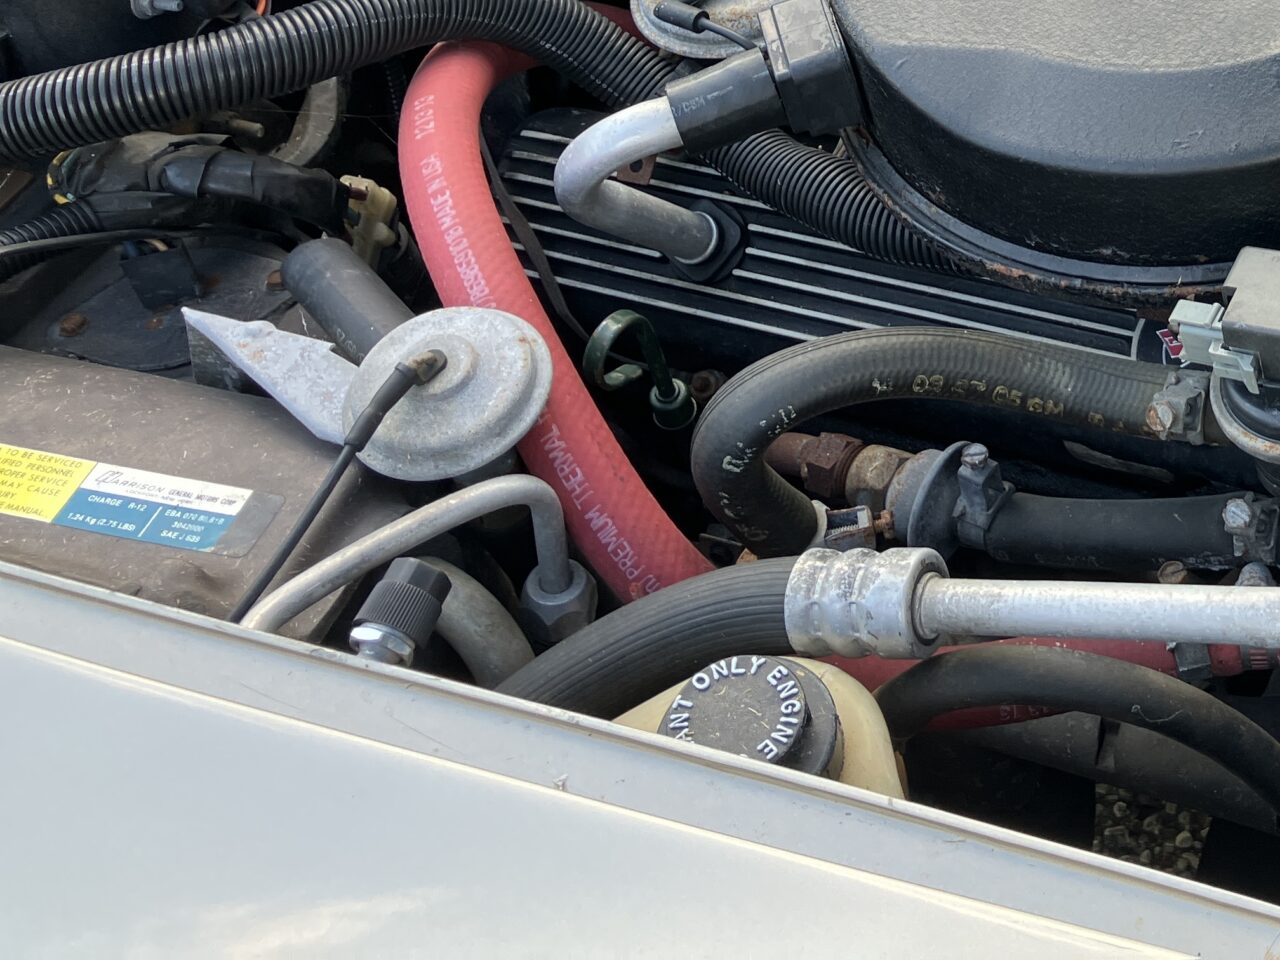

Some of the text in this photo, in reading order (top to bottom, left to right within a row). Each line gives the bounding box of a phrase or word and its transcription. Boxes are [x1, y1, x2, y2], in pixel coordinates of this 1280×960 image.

[420, 151, 443, 180] USA
[430, 190, 457, 230] MADE
[6, 448, 82, 469] TO BE SERVICED
[26, 463, 74, 478] PERSONNEL
[540, 424, 593, 510] THERMAL
[0, 468, 68, 487] ROPER SERVICE
[27, 485, 61, 497] CAUSE
[87, 494, 123, 507] CHARGE
[584, 504, 646, 581] PREMIUM
[692, 656, 767, 691] ONLY
[756, 665, 802, 760] ENGINE
